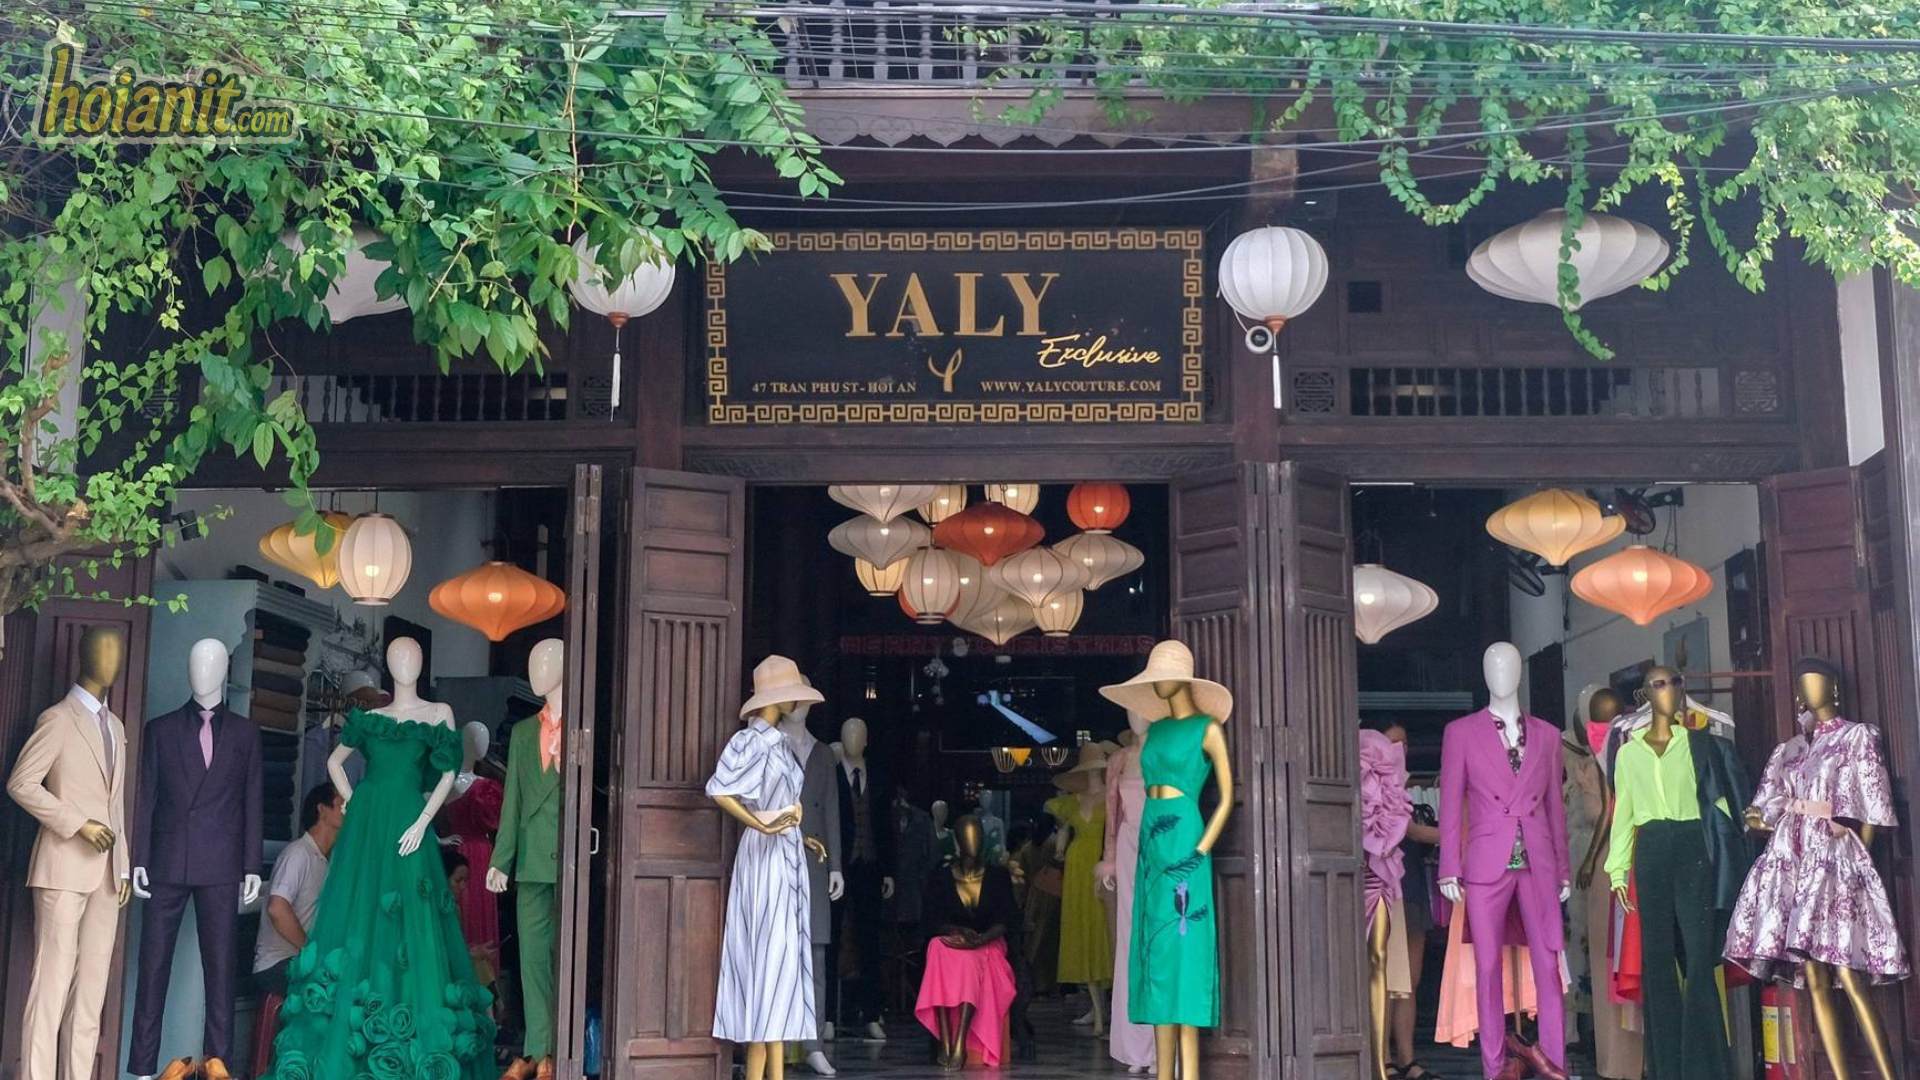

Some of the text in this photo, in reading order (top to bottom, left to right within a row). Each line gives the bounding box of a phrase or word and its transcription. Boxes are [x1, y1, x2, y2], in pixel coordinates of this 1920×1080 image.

[829, 272, 1060, 337] YALY
[1037, 334, 1161, 368] Exclusive
[752, 382, 767, 393] 47
[770, 382, 807, 393] TRAN
[811, 382, 840, 393] PHU
[897, 382, 917, 393] AN
[980, 380, 1161, 393] WWW.YALYCOUTURE.COM
